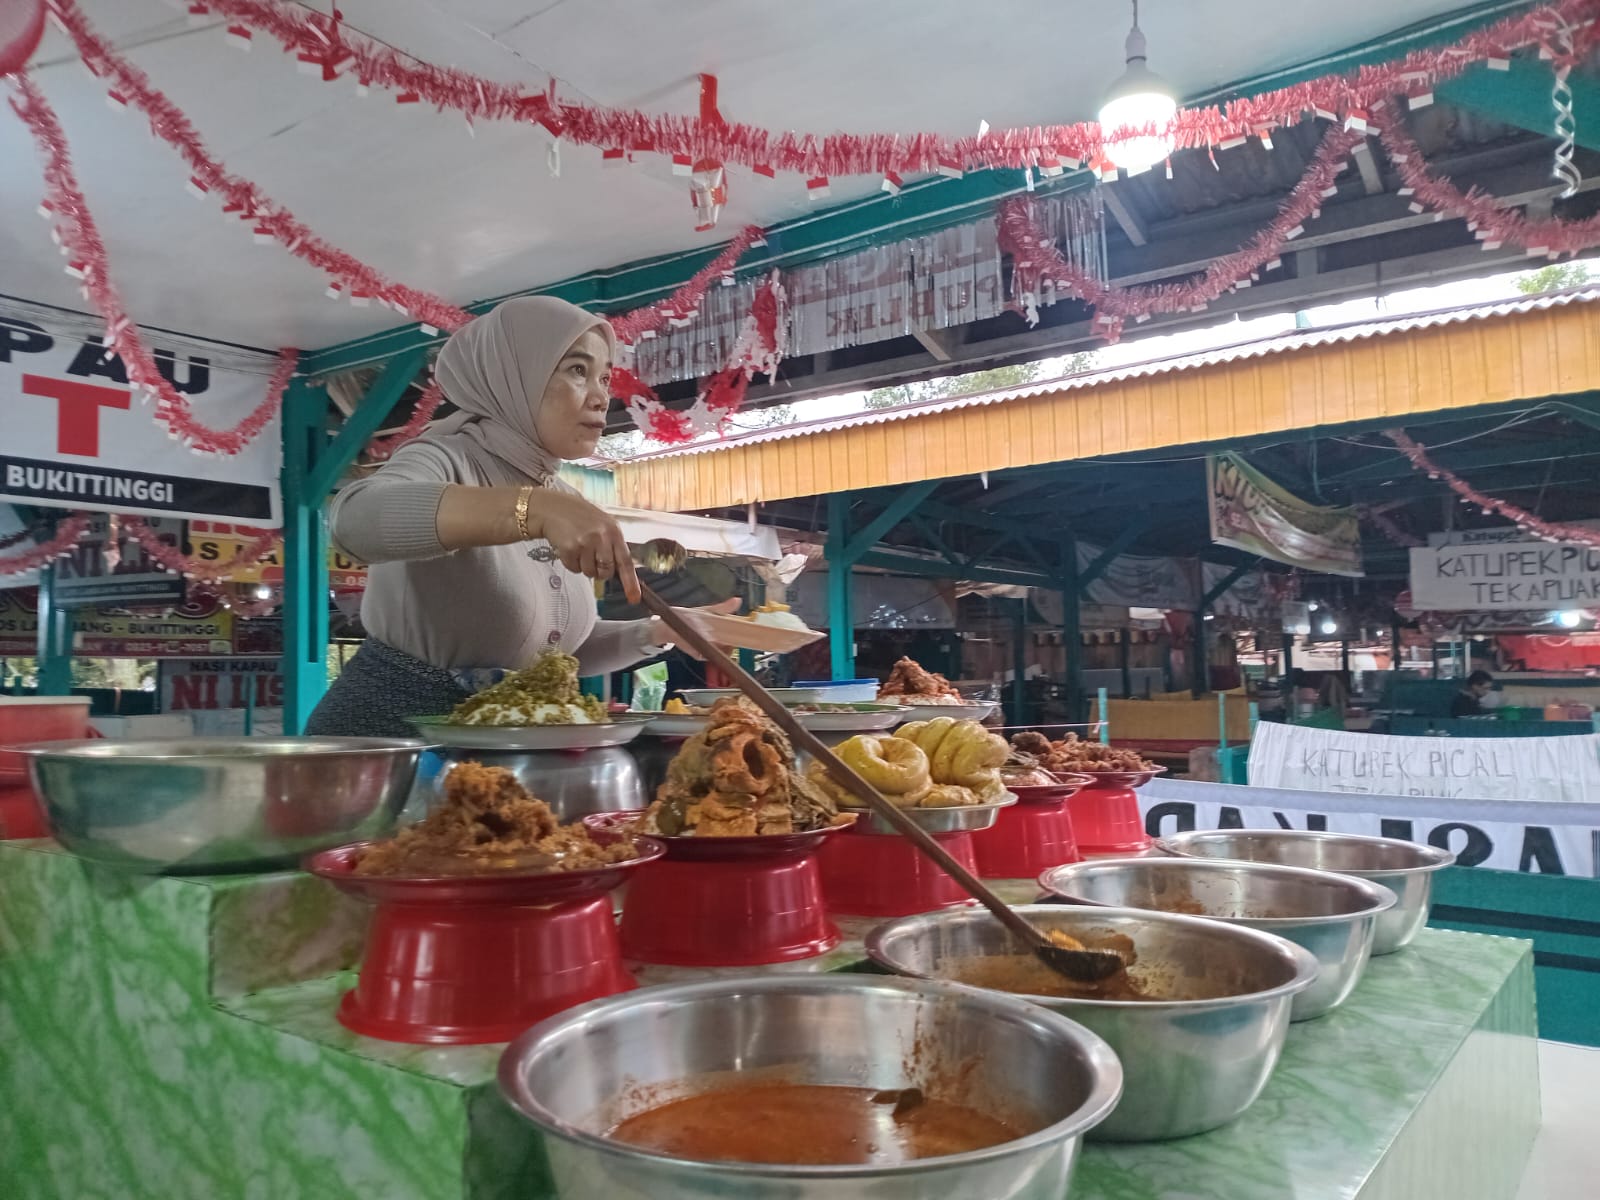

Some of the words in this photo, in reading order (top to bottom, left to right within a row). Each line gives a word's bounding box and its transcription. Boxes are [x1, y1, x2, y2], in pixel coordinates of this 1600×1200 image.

[6, 463, 174, 503] BUKITTINGGI
[1436, 549, 1558, 579] KATUPEK
[1469, 582, 1522, 604] TEK
[127, 622, 219, 635] BUKITTINGGI
[190, 661, 226, 672] NASI
[230, 661, 278, 672] KAPAU
[1302, 747, 1411, 778] KATUPEK
[1429, 749, 1512, 778] PICAL
